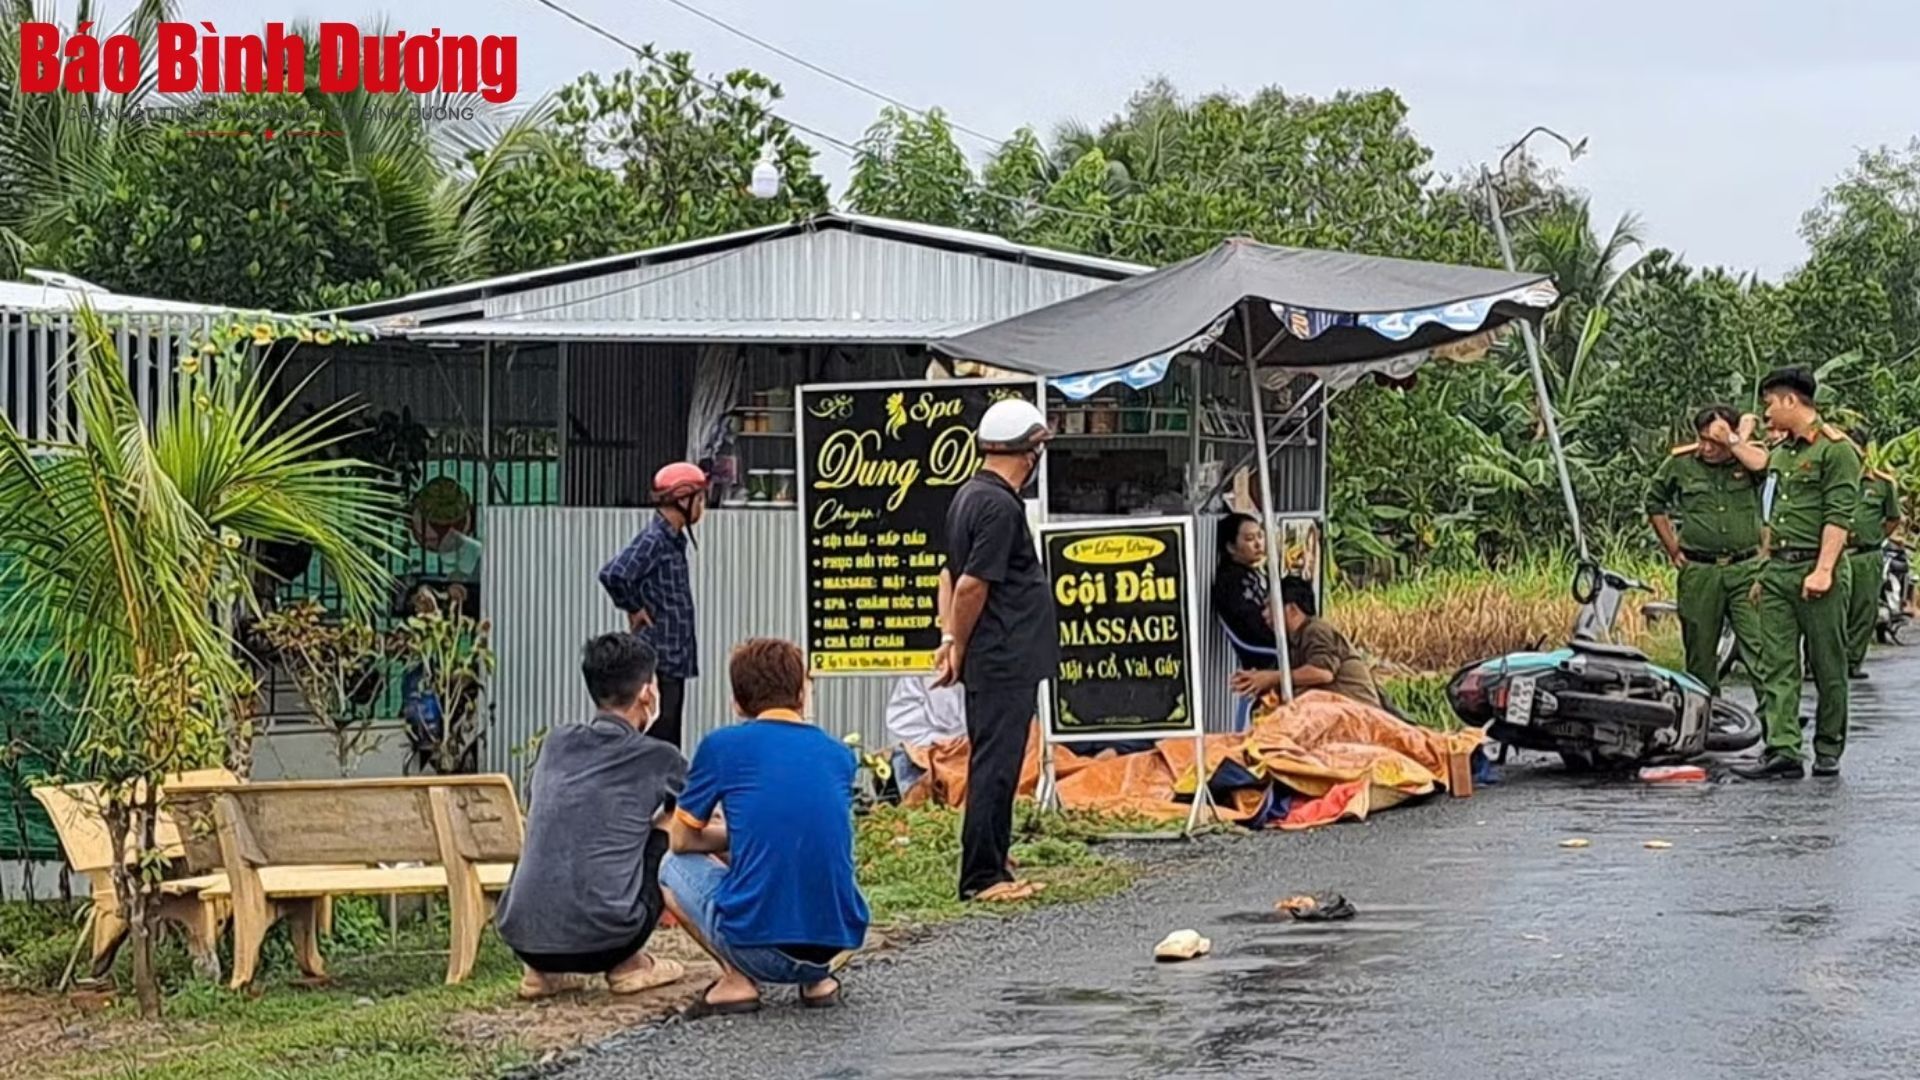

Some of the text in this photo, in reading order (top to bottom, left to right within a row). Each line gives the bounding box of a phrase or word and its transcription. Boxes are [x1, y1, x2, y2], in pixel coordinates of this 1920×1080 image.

[910, 392, 964, 428] Spa
[813, 429, 921, 512] Dung
[824, 598, 846, 610] SPA
[1055, 562, 1177, 614] Gội Đầu
[1058, 616, 1179, 647] MASSAGE
